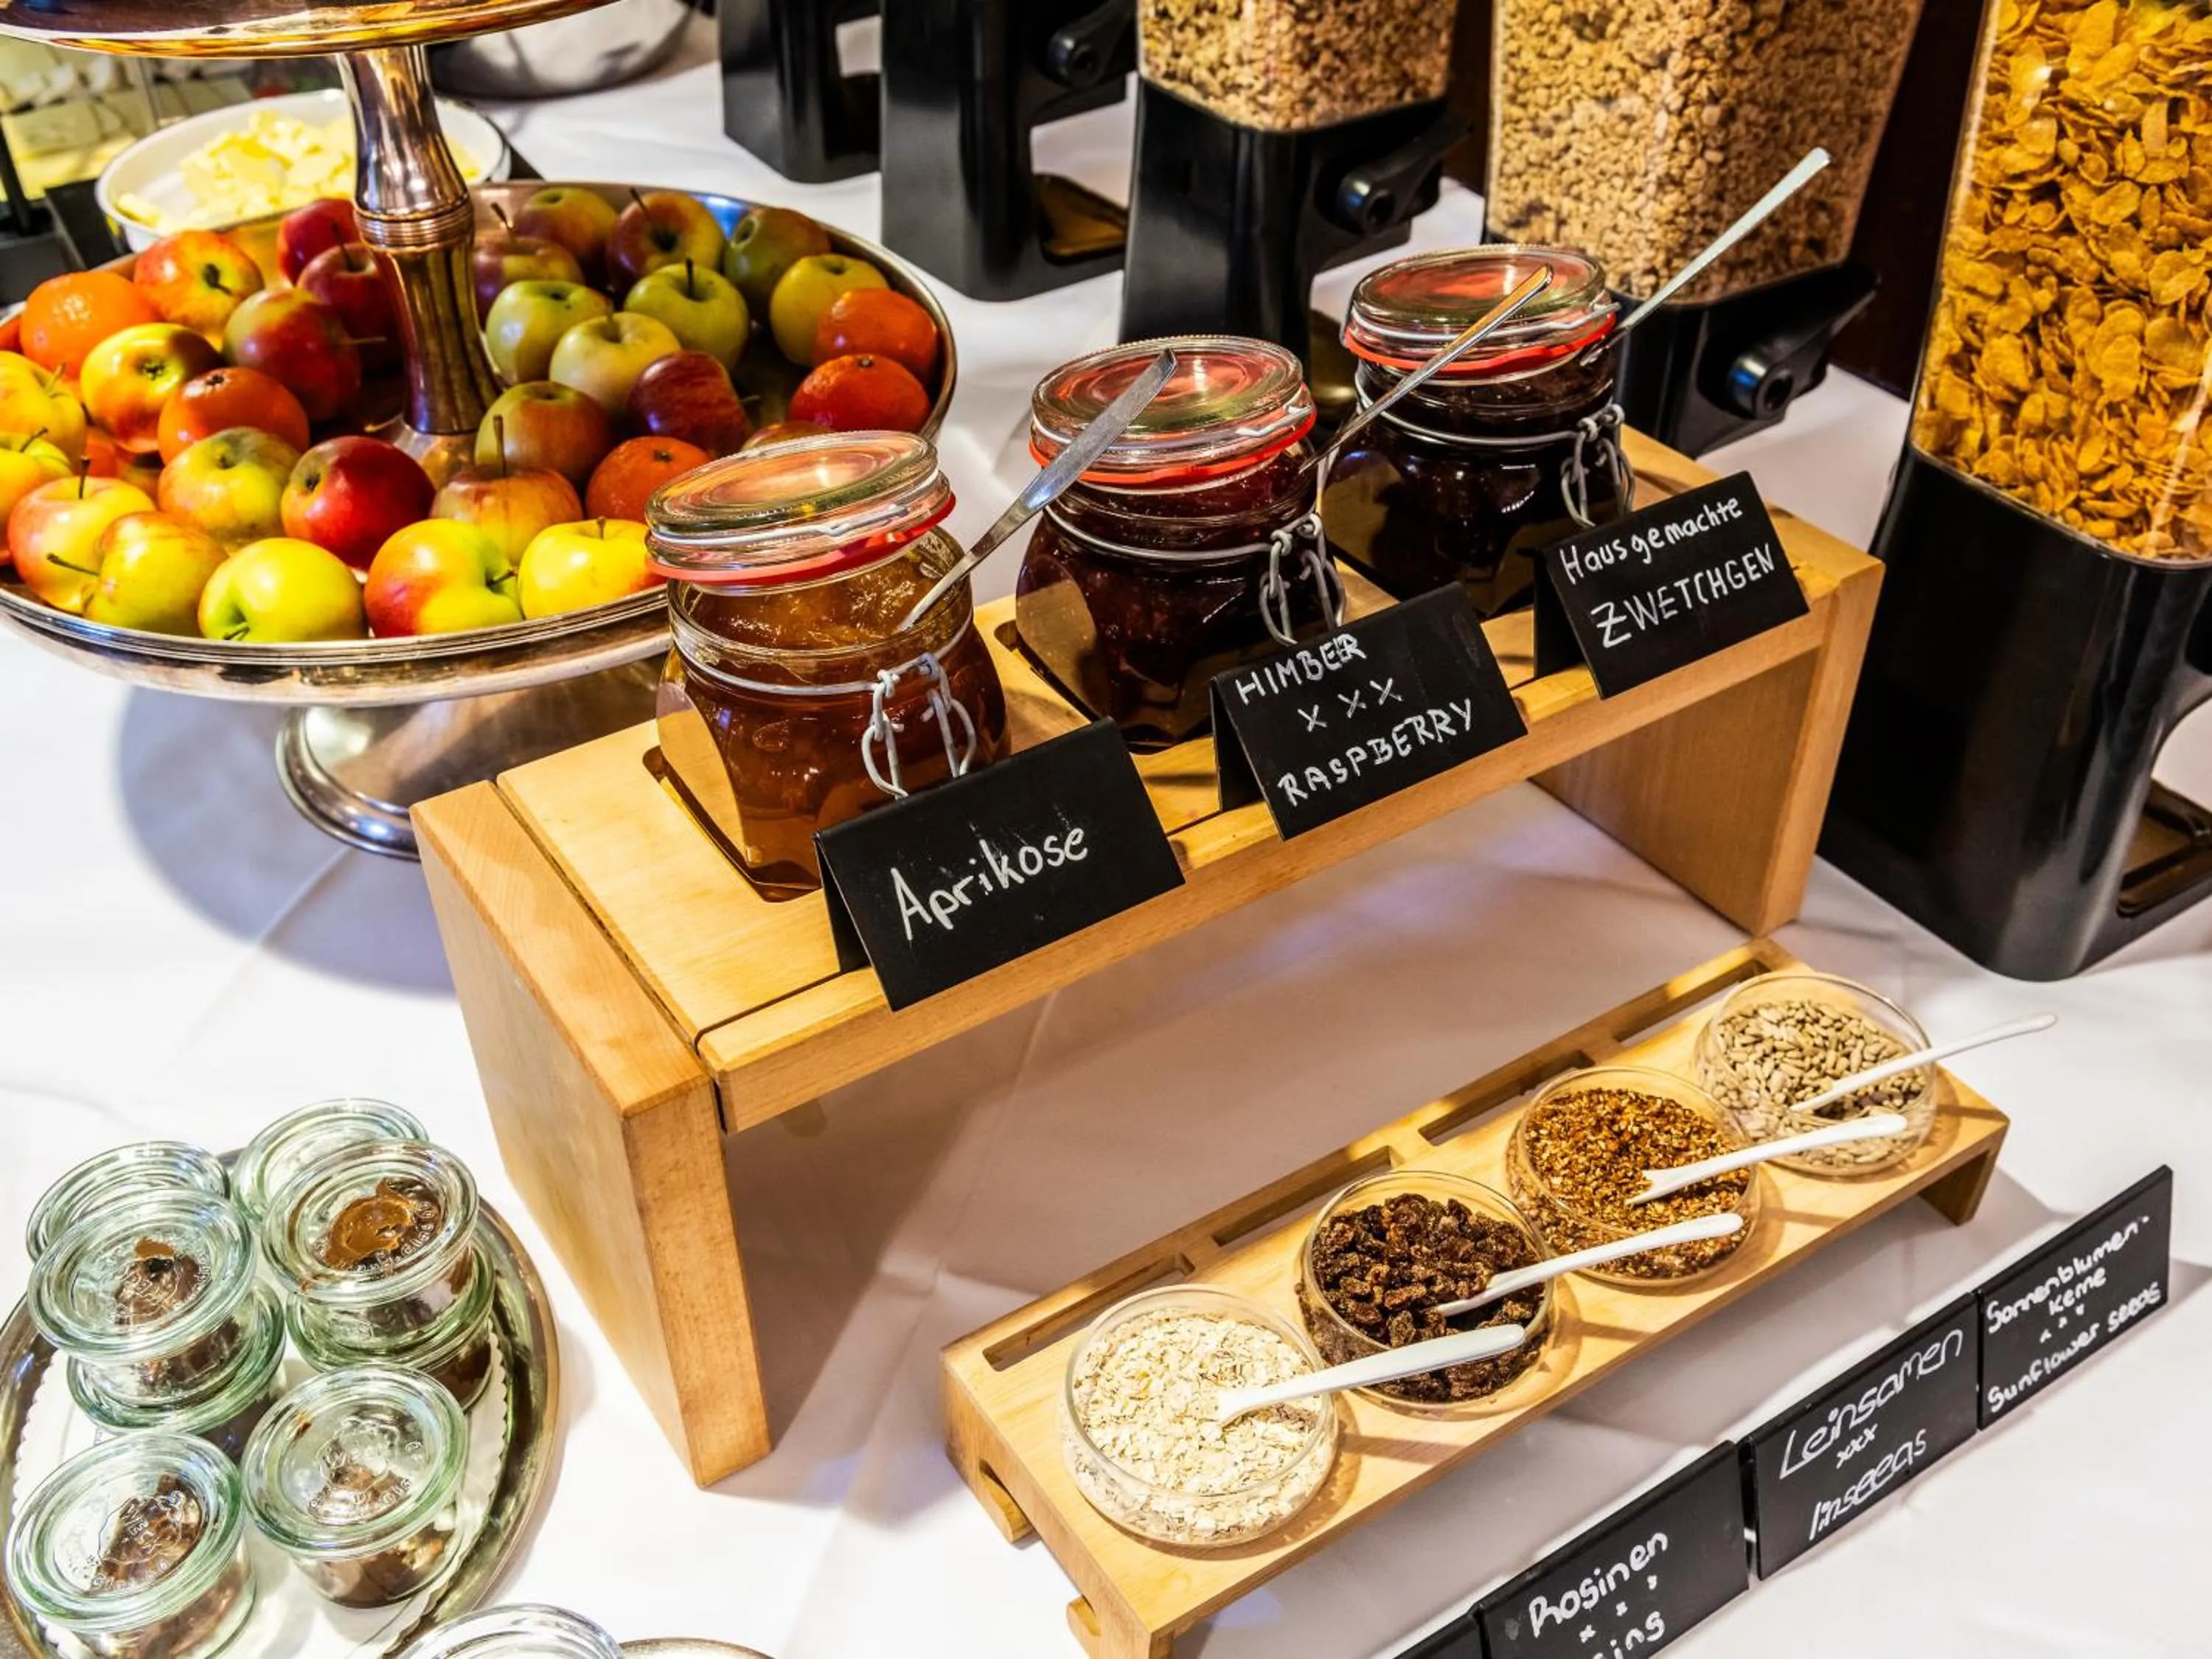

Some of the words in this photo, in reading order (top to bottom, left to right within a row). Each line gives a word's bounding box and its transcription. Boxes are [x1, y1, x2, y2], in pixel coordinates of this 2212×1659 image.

[1590, 543, 1775, 649] ZWETCHGEN
[1235, 633, 1367, 704] HIMBER
[1277, 698, 1472, 807] RASPBERRY
[890, 827, 1088, 939] Aprikose
[1779, 1329, 1963, 1479] Leinsamen
[1528, 1531, 1669, 1638] Rosinen
